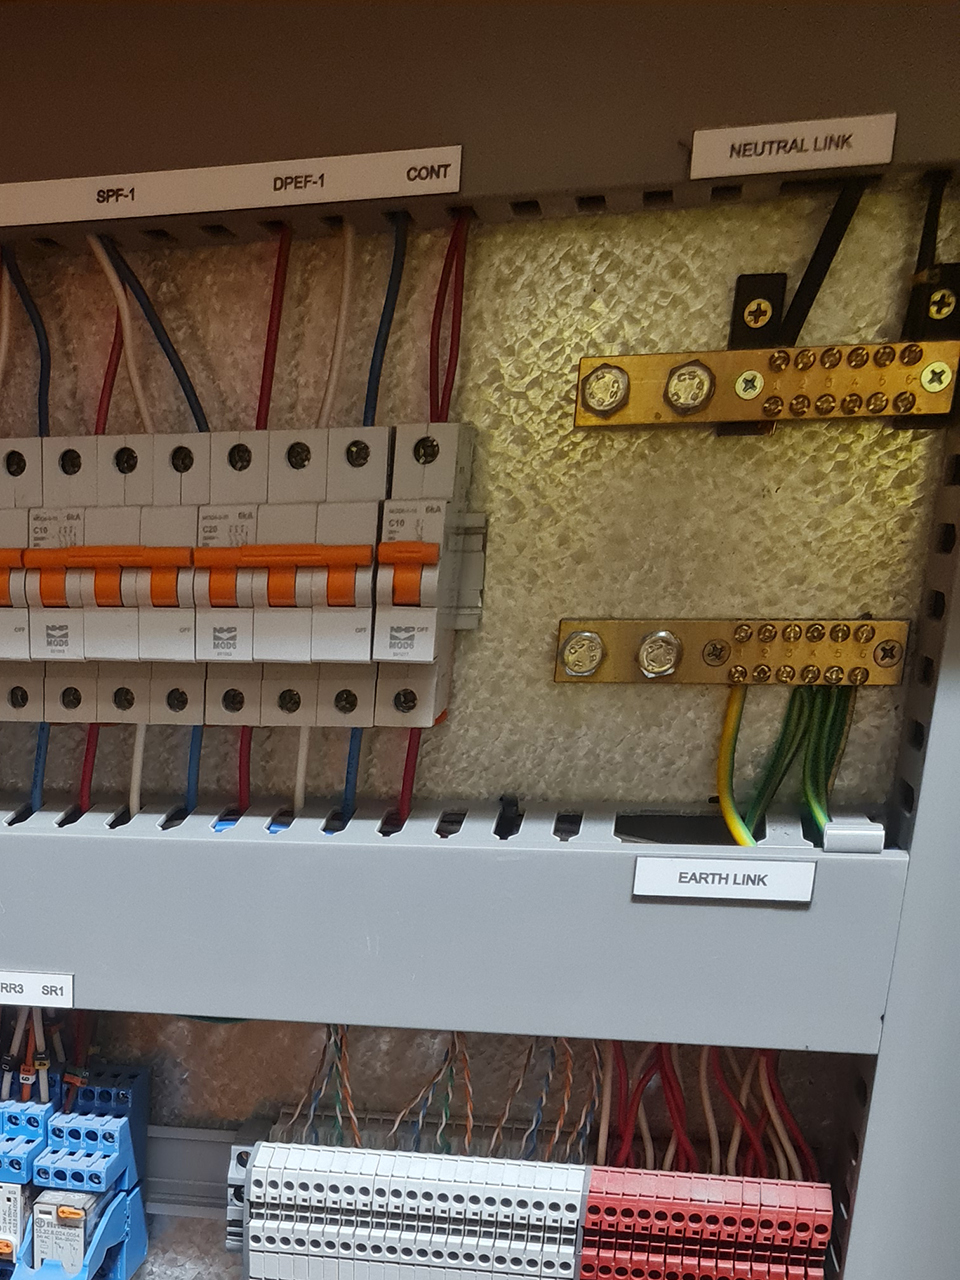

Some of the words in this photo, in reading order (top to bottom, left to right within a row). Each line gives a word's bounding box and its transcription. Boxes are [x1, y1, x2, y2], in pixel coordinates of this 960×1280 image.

[729, 138, 808, 158] NEUTRAL
[813, 134, 854, 150] LINK
[406, 164, 452, 182] CONT
[272, 173, 326, 192] DPEF-1
[96, 187, 136, 204] SPF-1
[389, 641, 414, 649] MOD6
[678, 872, 730, 886] EARTH
[732, 874, 769, 887] LINK
[0, 982, 24, 994] RR3
[41, 985, 64, 996] SR1
